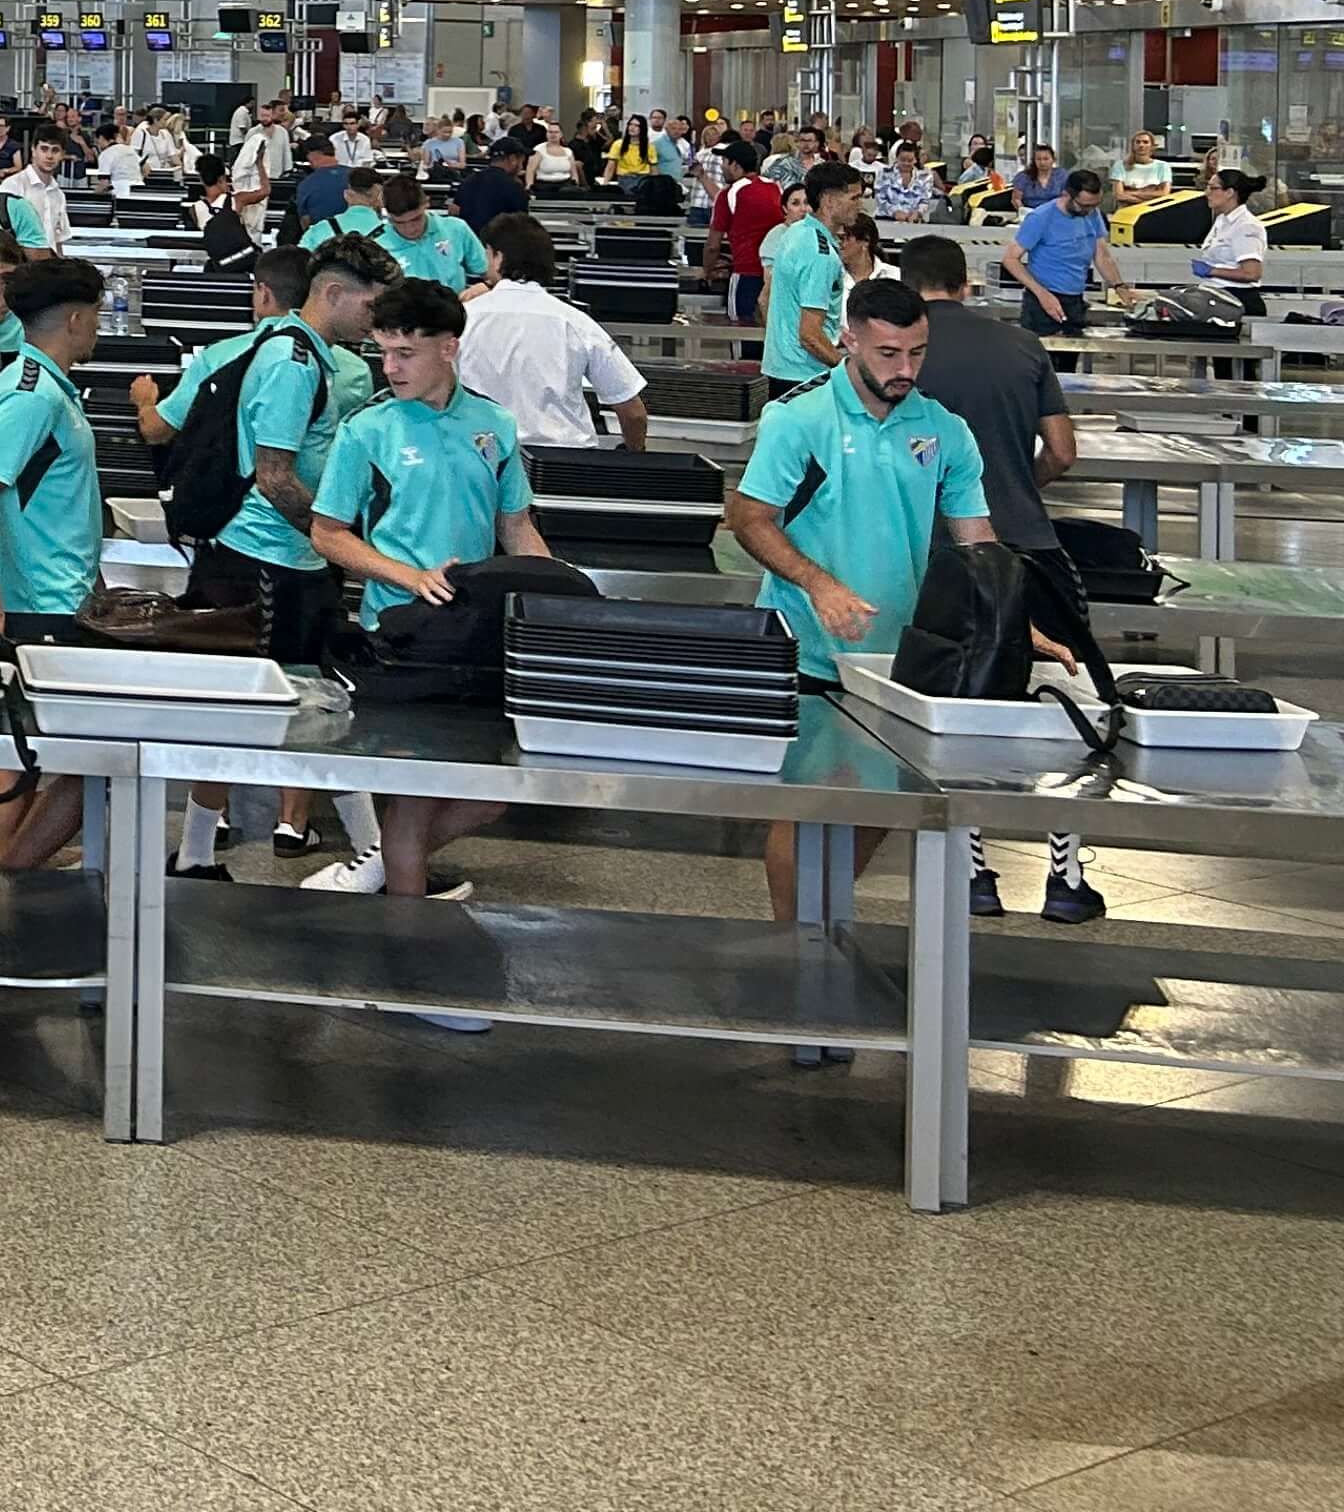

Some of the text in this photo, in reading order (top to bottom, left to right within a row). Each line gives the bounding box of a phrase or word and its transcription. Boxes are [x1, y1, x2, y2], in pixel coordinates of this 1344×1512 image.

[40, 14, 60, 27] 359
[80, 14, 101, 27] 360
[145, 14, 166, 27] 361
[258, 14, 281, 27] 362
